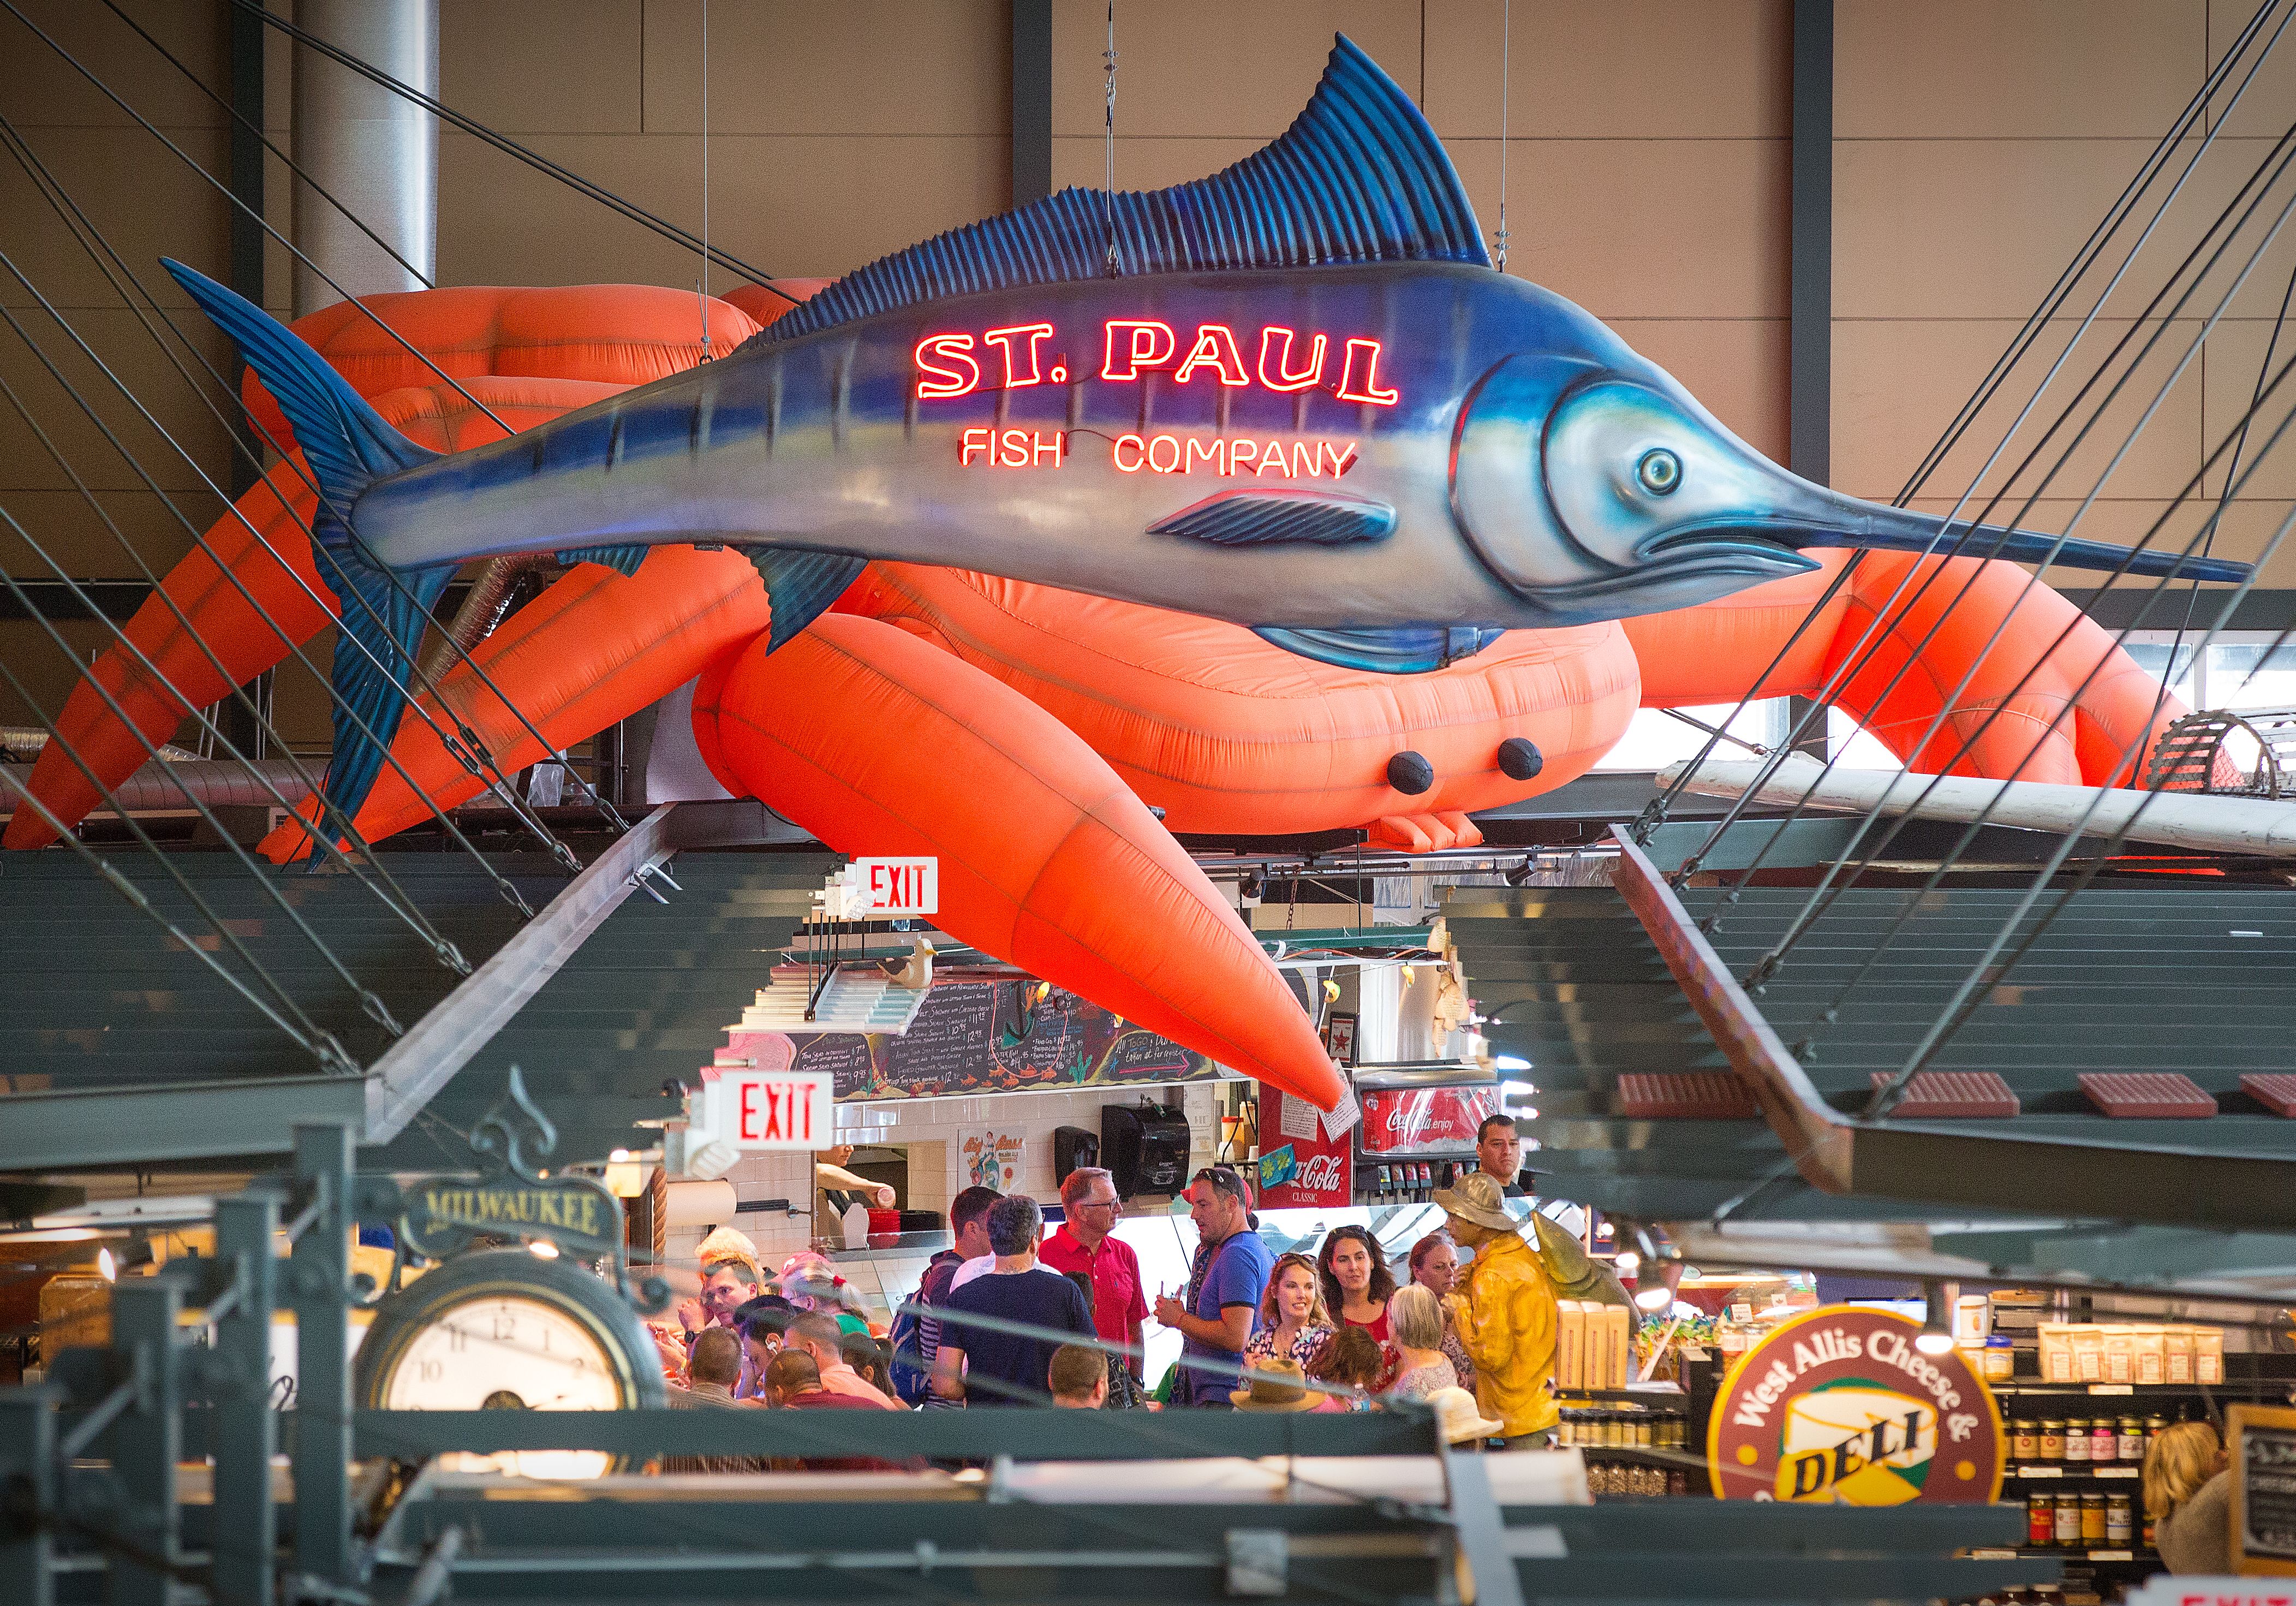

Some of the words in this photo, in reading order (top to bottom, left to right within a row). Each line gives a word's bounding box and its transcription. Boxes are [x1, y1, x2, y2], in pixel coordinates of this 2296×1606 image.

[915, 323, 1068, 399] ST.
[1101, 320, 1398, 406] PAUL
[962, 429, 1063, 468] FISH
[1113, 434, 1356, 479] COMPANY
[870, 864, 928, 908] EXIT
[741, 1084, 817, 1141] EXIT
[427, 1190, 600, 1237] MILWAUKEE
[1292, 1192, 1317, 1203] CLASSIC
[493, 1316, 516, 1341] 12
[419, 1361, 442, 1383] 10
[1733, 1359, 1798, 1428] West
[1792, 1327, 1864, 1373] Allis
[1866, 1330, 1963, 1411] Cheese
[1946, 1413, 1979, 1443] &
[1792, 1409, 1924, 1499] DELI
